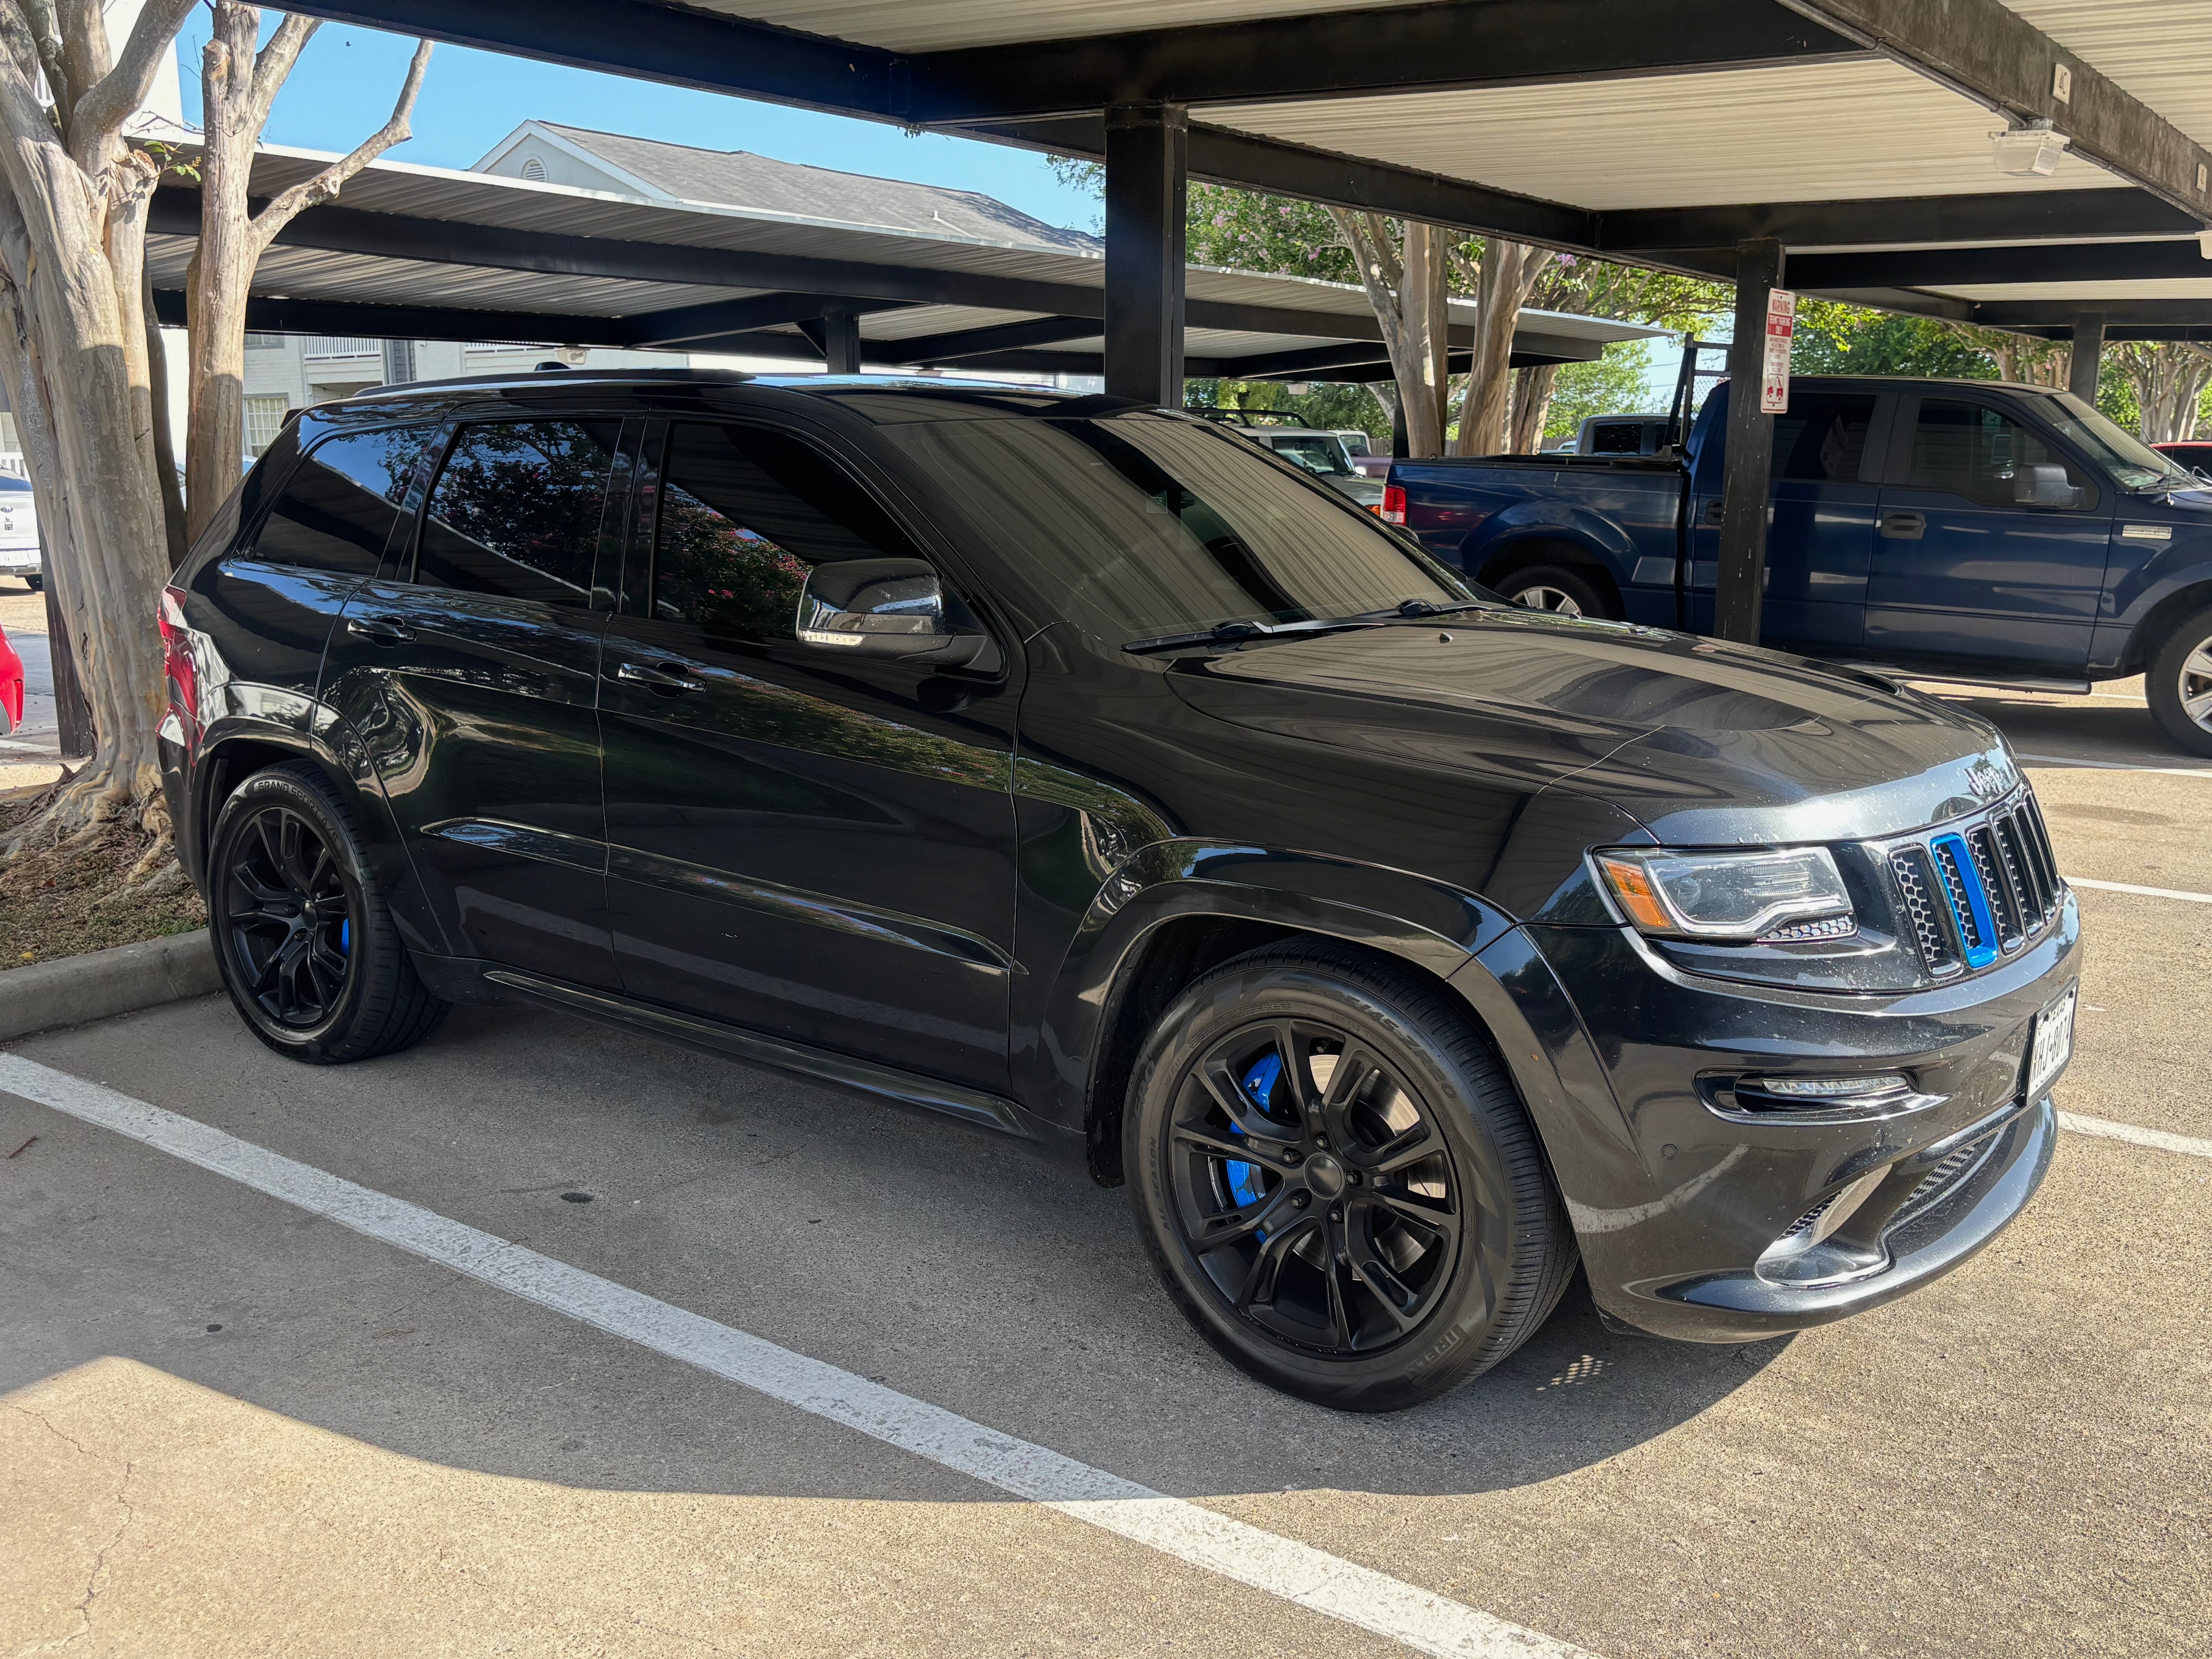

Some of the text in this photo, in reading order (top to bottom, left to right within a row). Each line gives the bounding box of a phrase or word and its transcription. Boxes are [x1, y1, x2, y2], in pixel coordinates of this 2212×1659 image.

[258, 781, 339, 842] GRAND SPORT A/S
[1964, 767, 2003, 795] Jeep
[1312, 984, 1399, 1032] 295/45
[1398, 1035, 1457, 1099] ZR20
[1149, 1136, 1170, 1231] ALL SEASON
[1403, 1323, 1471, 1386] PIRELLI
